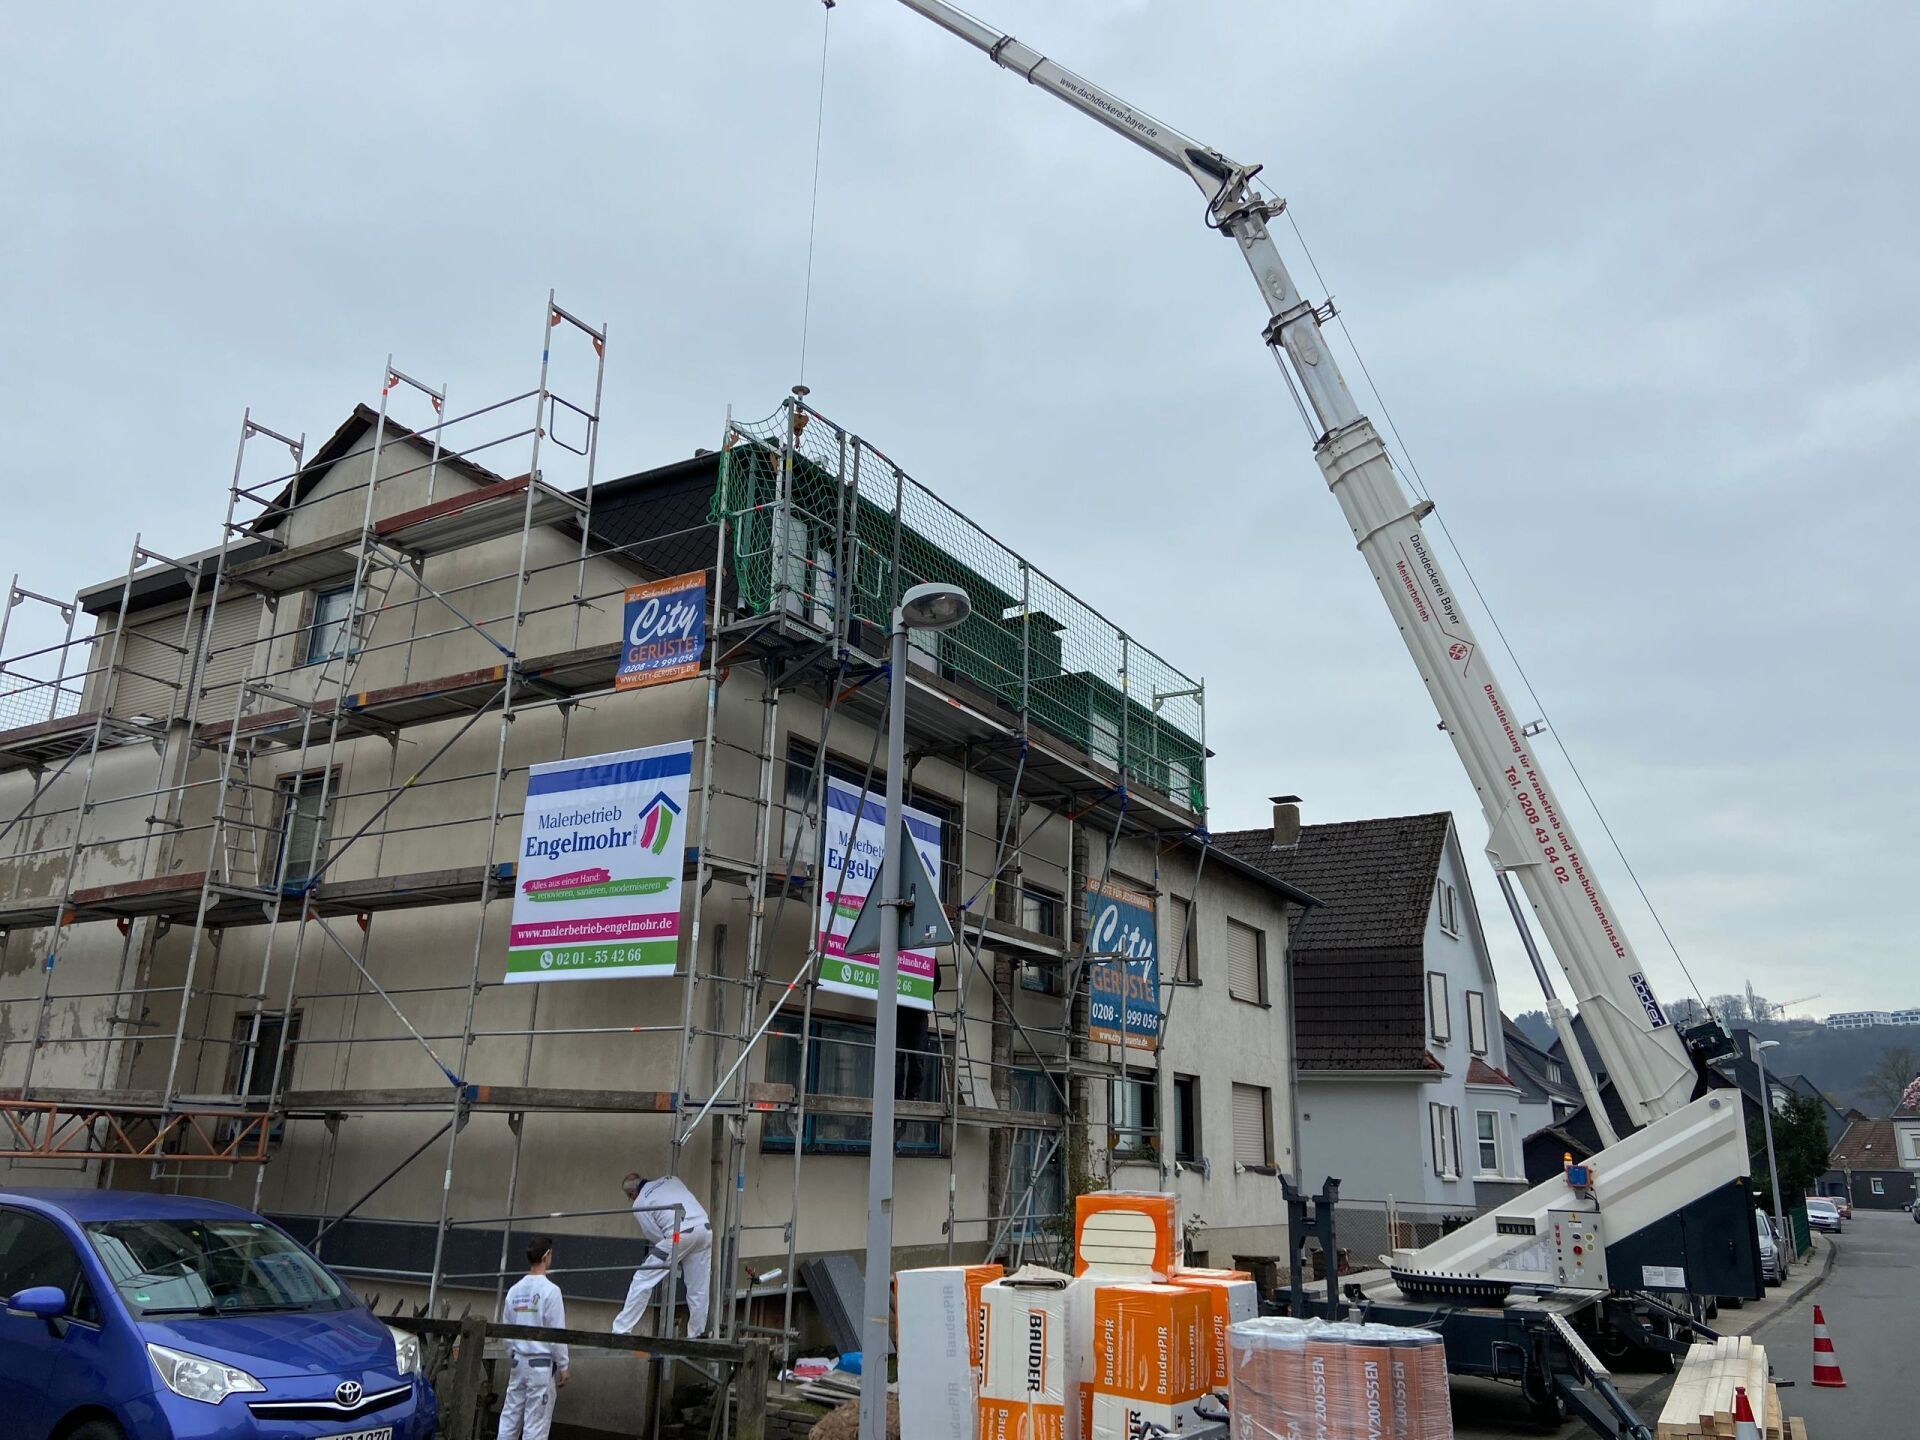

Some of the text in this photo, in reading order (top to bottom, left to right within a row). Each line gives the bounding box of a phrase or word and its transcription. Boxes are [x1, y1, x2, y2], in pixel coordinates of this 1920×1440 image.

[1060, 77, 1157, 139] www.dachdeckerei-bayer.de
[1396, 561, 1429, 623] Meisterbetrieb
[1410, 534, 1459, 625] Dachdeckerei Bayer
[630, 598, 698, 645] City
[624, 663, 646, 673] 0208
[652, 660, 659, 668] 2
[661, 657, 676, 667] 999
[629, 637, 693, 663] GERÜSTE
[538, 806, 622, 830] Malerbetrieb
[1483, 684, 1626, 960] Dienstleistung für Kranbetrieb und Hebebühneneinsatz
[1504, 765, 1570, 885] Tel. 0208 43 84 02
[525, 827, 632, 860] Engelmohr
[827, 847, 879, 880] Engel
[838, 830, 885, 858] Mlerbetr
[531, 874, 601, 890] Alles aus einer Hand:
[537, 881, 661, 900] renovieren, sanieren, modernisieren
[518, 918, 672, 939] www.malerbetrieb-engelmohr.de
[1092, 904, 1155, 984] City
[556, 953, 571, 965] 02
[572, 952, 586, 965] 01
[594, 951, 608, 963] 55
[611, 949, 625, 962] 42
[627, 948, 641, 962] 66
[854, 970, 864, 982] 02
[865, 972, 875, 984] 01
[902, 980, 912, 992] 66
[1630, 974, 1663, 1026] Böcker
[1092, 1003, 1114, 1021] 0208
[1126, 1010, 1142, 1026] 999
[1142, 1013, 1158, 1030] 056
[1027, 1315, 1042, 1392] BAUDER
[1104, 1319, 1114, 1386] BauderPIR
[1157, 1326, 1168, 1395] BauderPIR
[1213, 1315, 1225, 1378] BauderPIR
[948, 1382, 961, 1440] uderPIR
